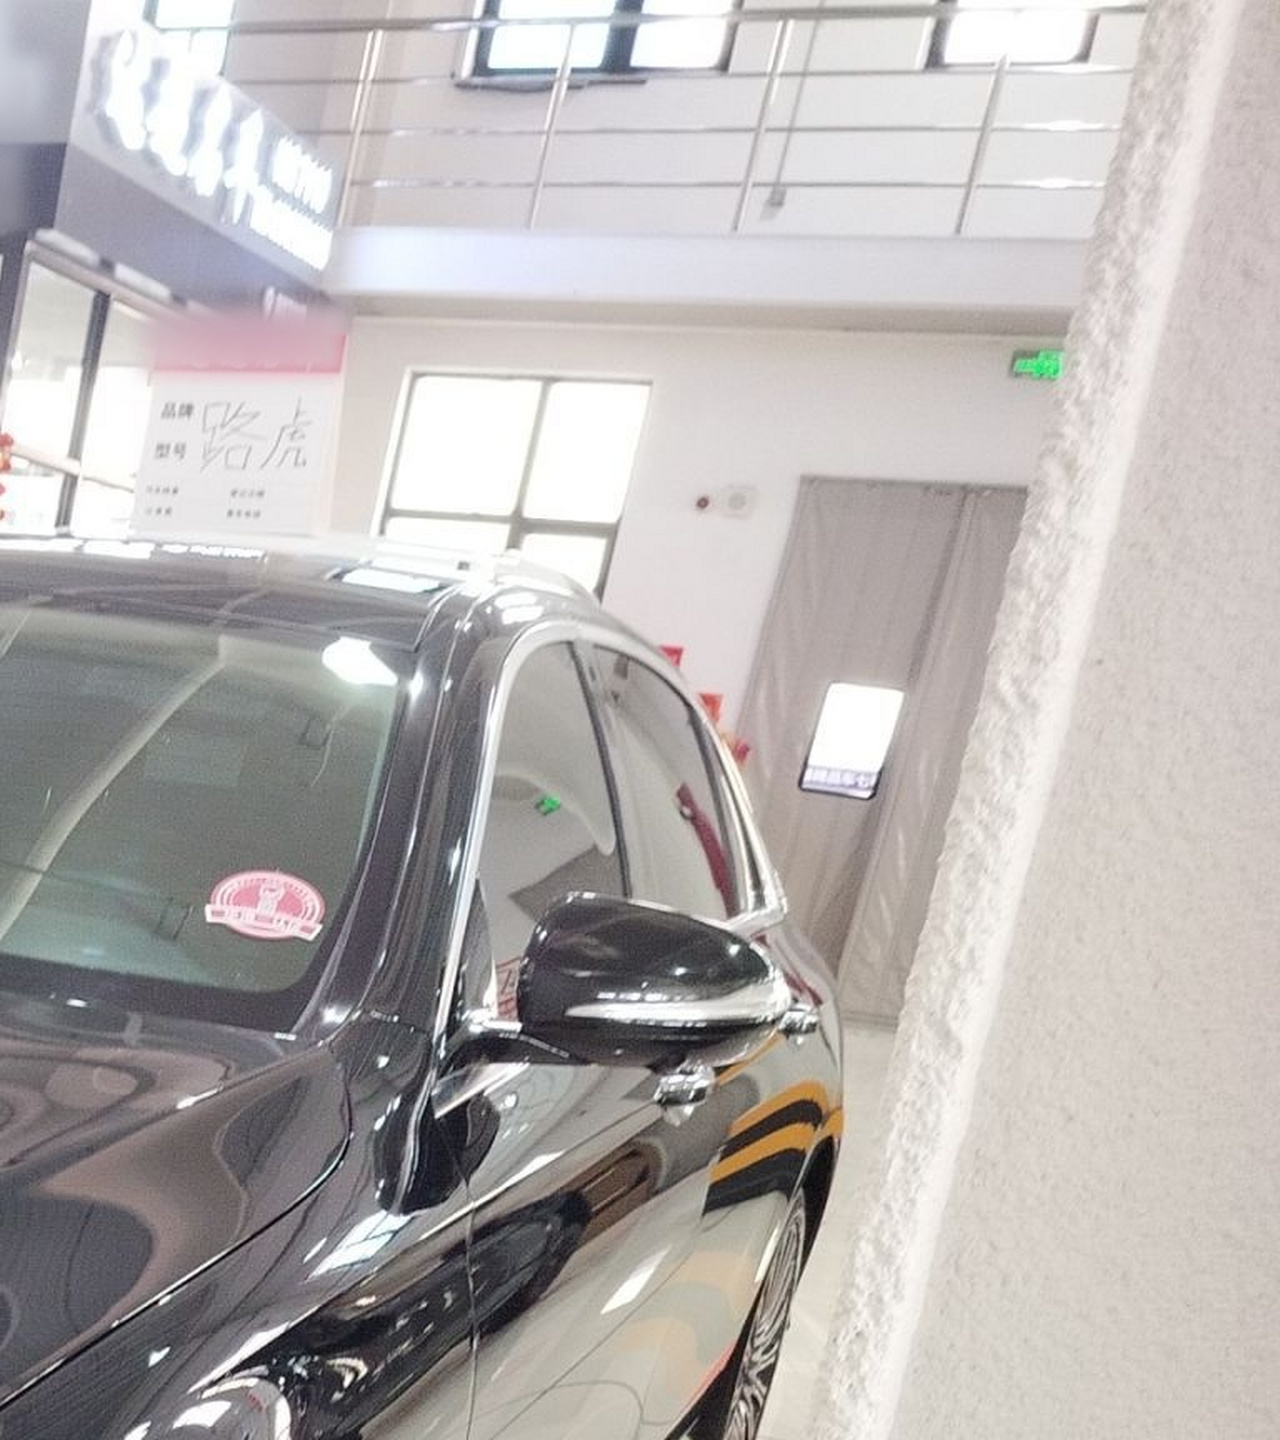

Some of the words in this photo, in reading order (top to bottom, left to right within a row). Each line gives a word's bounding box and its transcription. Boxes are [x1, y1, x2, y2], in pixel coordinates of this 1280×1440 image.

[160, 401, 194, 419] 品牌
[200, 395, 313, 473] 路虎
[154, 441, 187, 461] 型号
